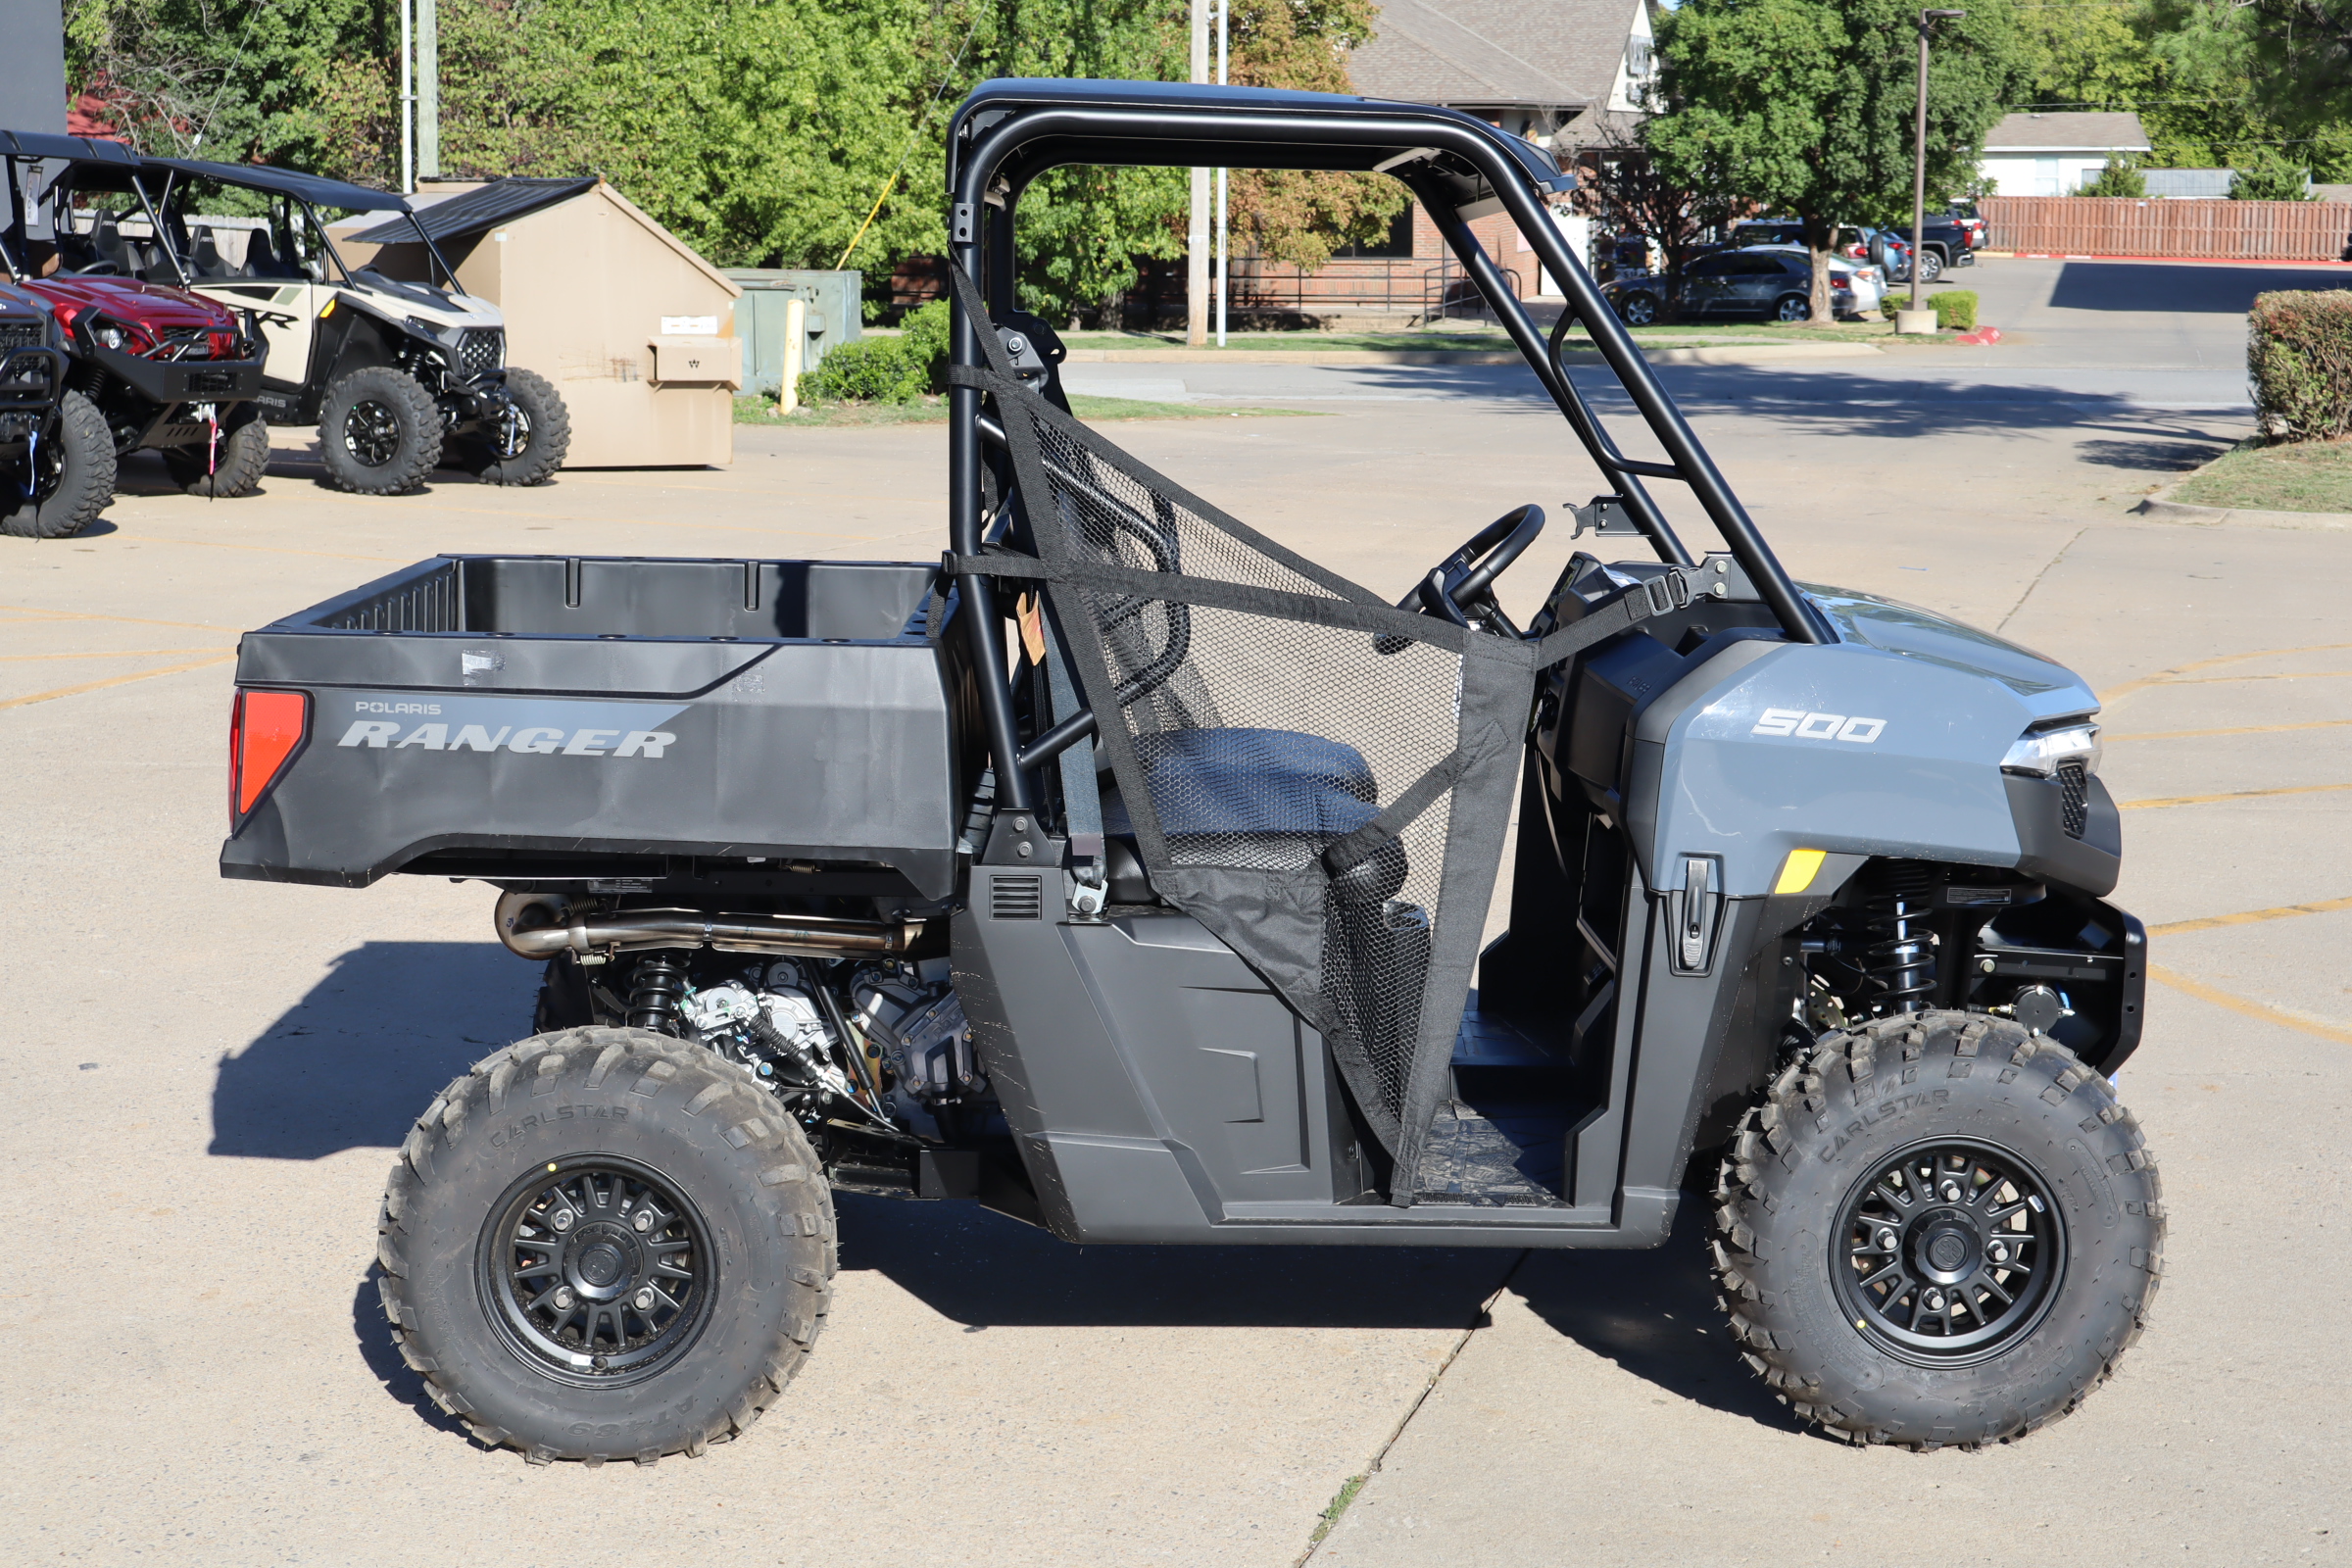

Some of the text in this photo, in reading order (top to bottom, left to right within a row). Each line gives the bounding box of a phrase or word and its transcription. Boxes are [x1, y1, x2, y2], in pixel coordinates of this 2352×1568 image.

[355, 701, 442, 714] POLARIS
[1750, 708, 1888, 744] 500
[337, 720, 677, 759] RANGER
[490, 1104, 629, 1150] CARLSTAR
[1817, 1088, 1948, 1164] CARLSTAR
[567, 1394, 694, 1438] AT489
